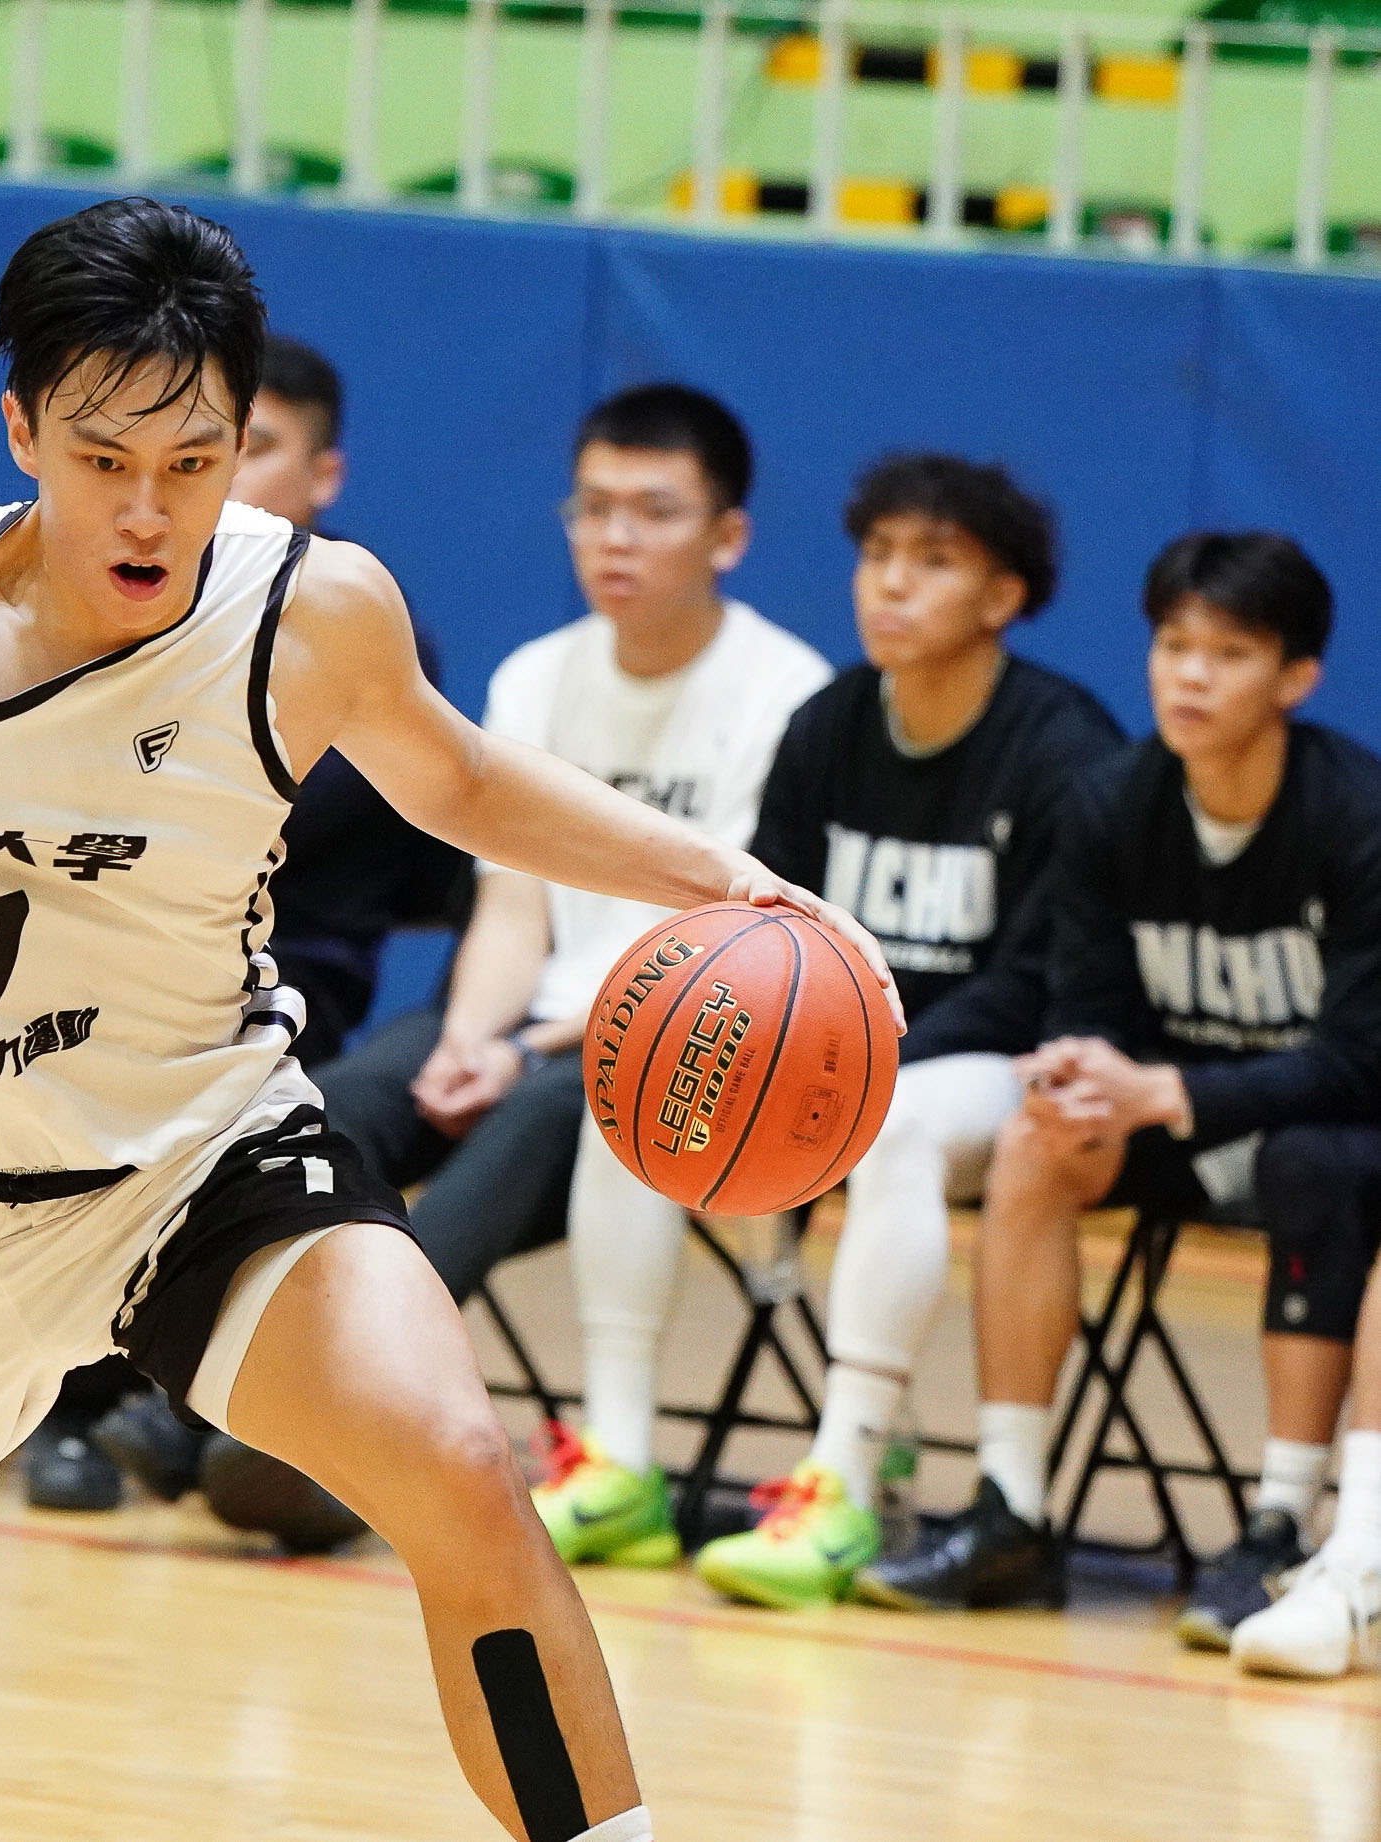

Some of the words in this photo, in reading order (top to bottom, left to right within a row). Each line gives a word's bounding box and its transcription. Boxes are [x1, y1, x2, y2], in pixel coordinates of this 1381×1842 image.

[596, 935, 705, 1141] SPALDING
[651, 981, 738, 1157] LEGACY
[697, 1010, 752, 1118] 1000
[729, 1070, 746, 1094] GAME
[739, 1048, 756, 1069] BALL
